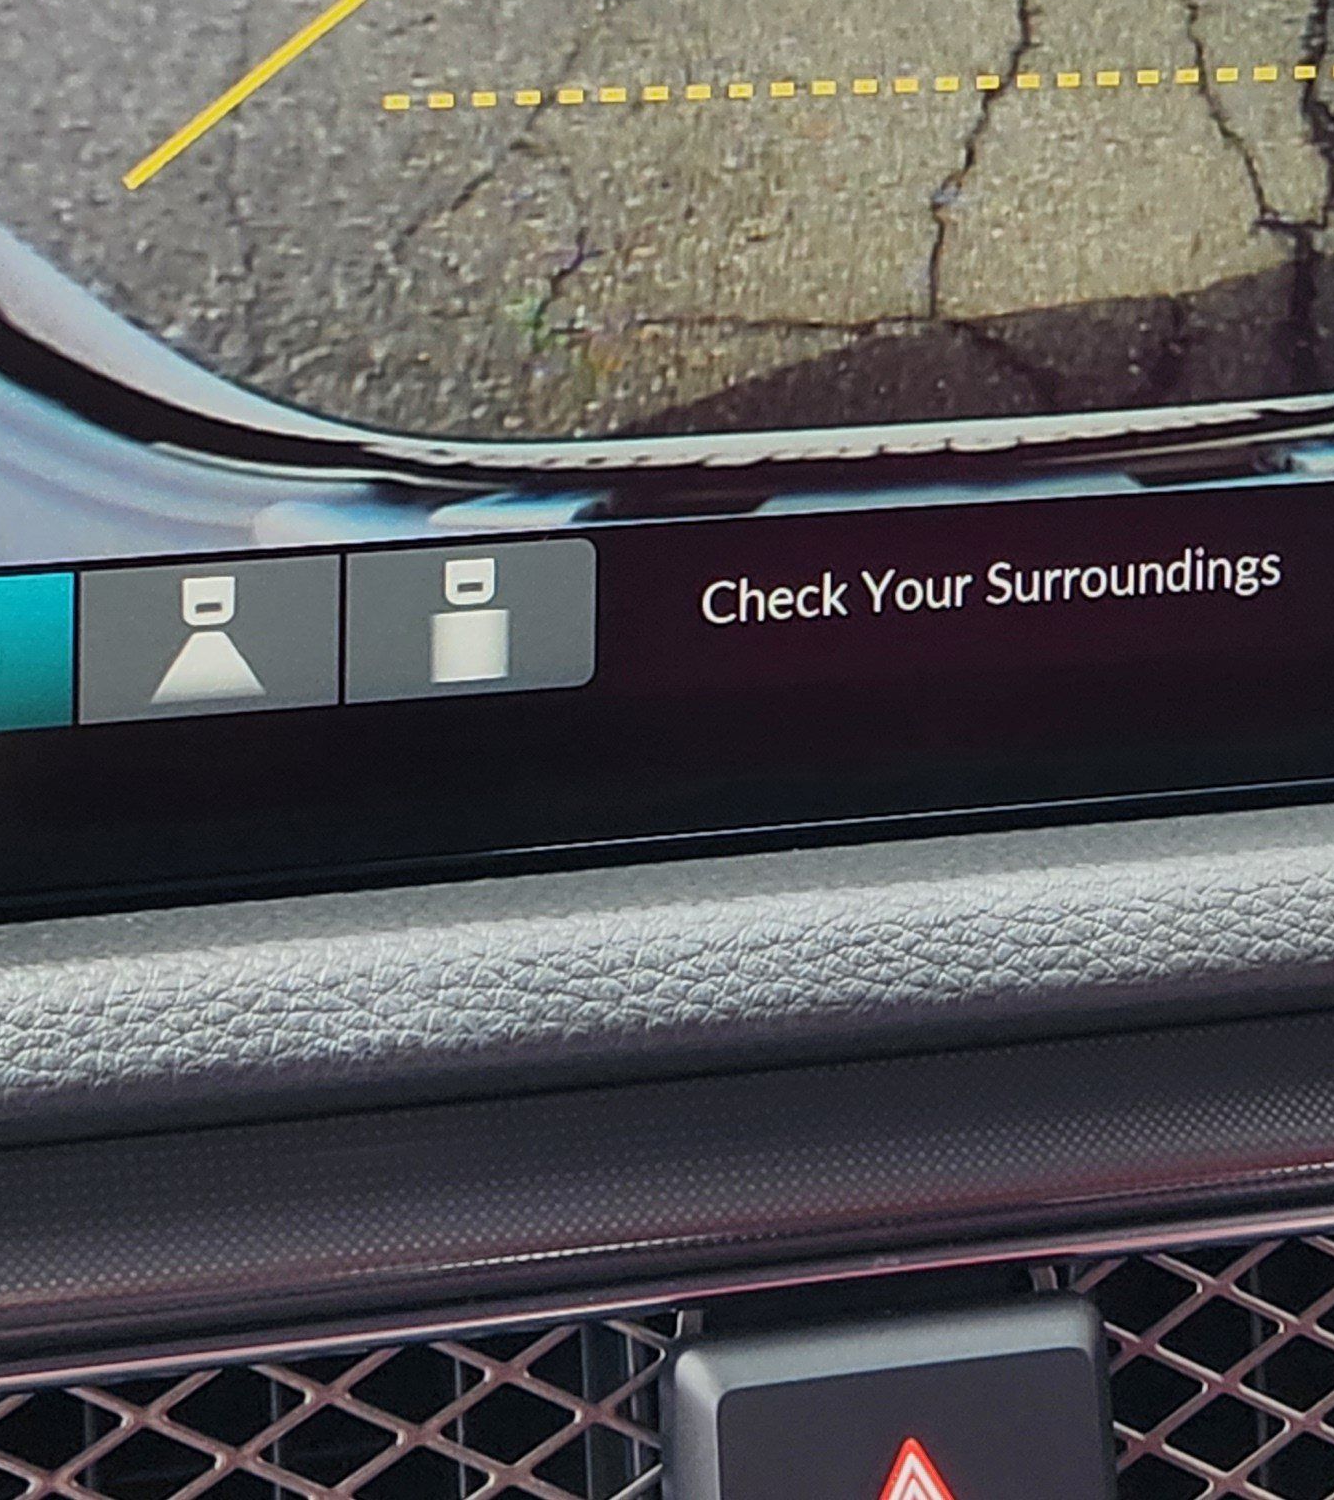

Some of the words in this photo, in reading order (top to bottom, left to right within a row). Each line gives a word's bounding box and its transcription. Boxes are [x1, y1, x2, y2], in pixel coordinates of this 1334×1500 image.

[701, 571, 849, 625] Check
[862, 567, 973, 615] Your
[985, 546, 1282, 606] Surroundings
